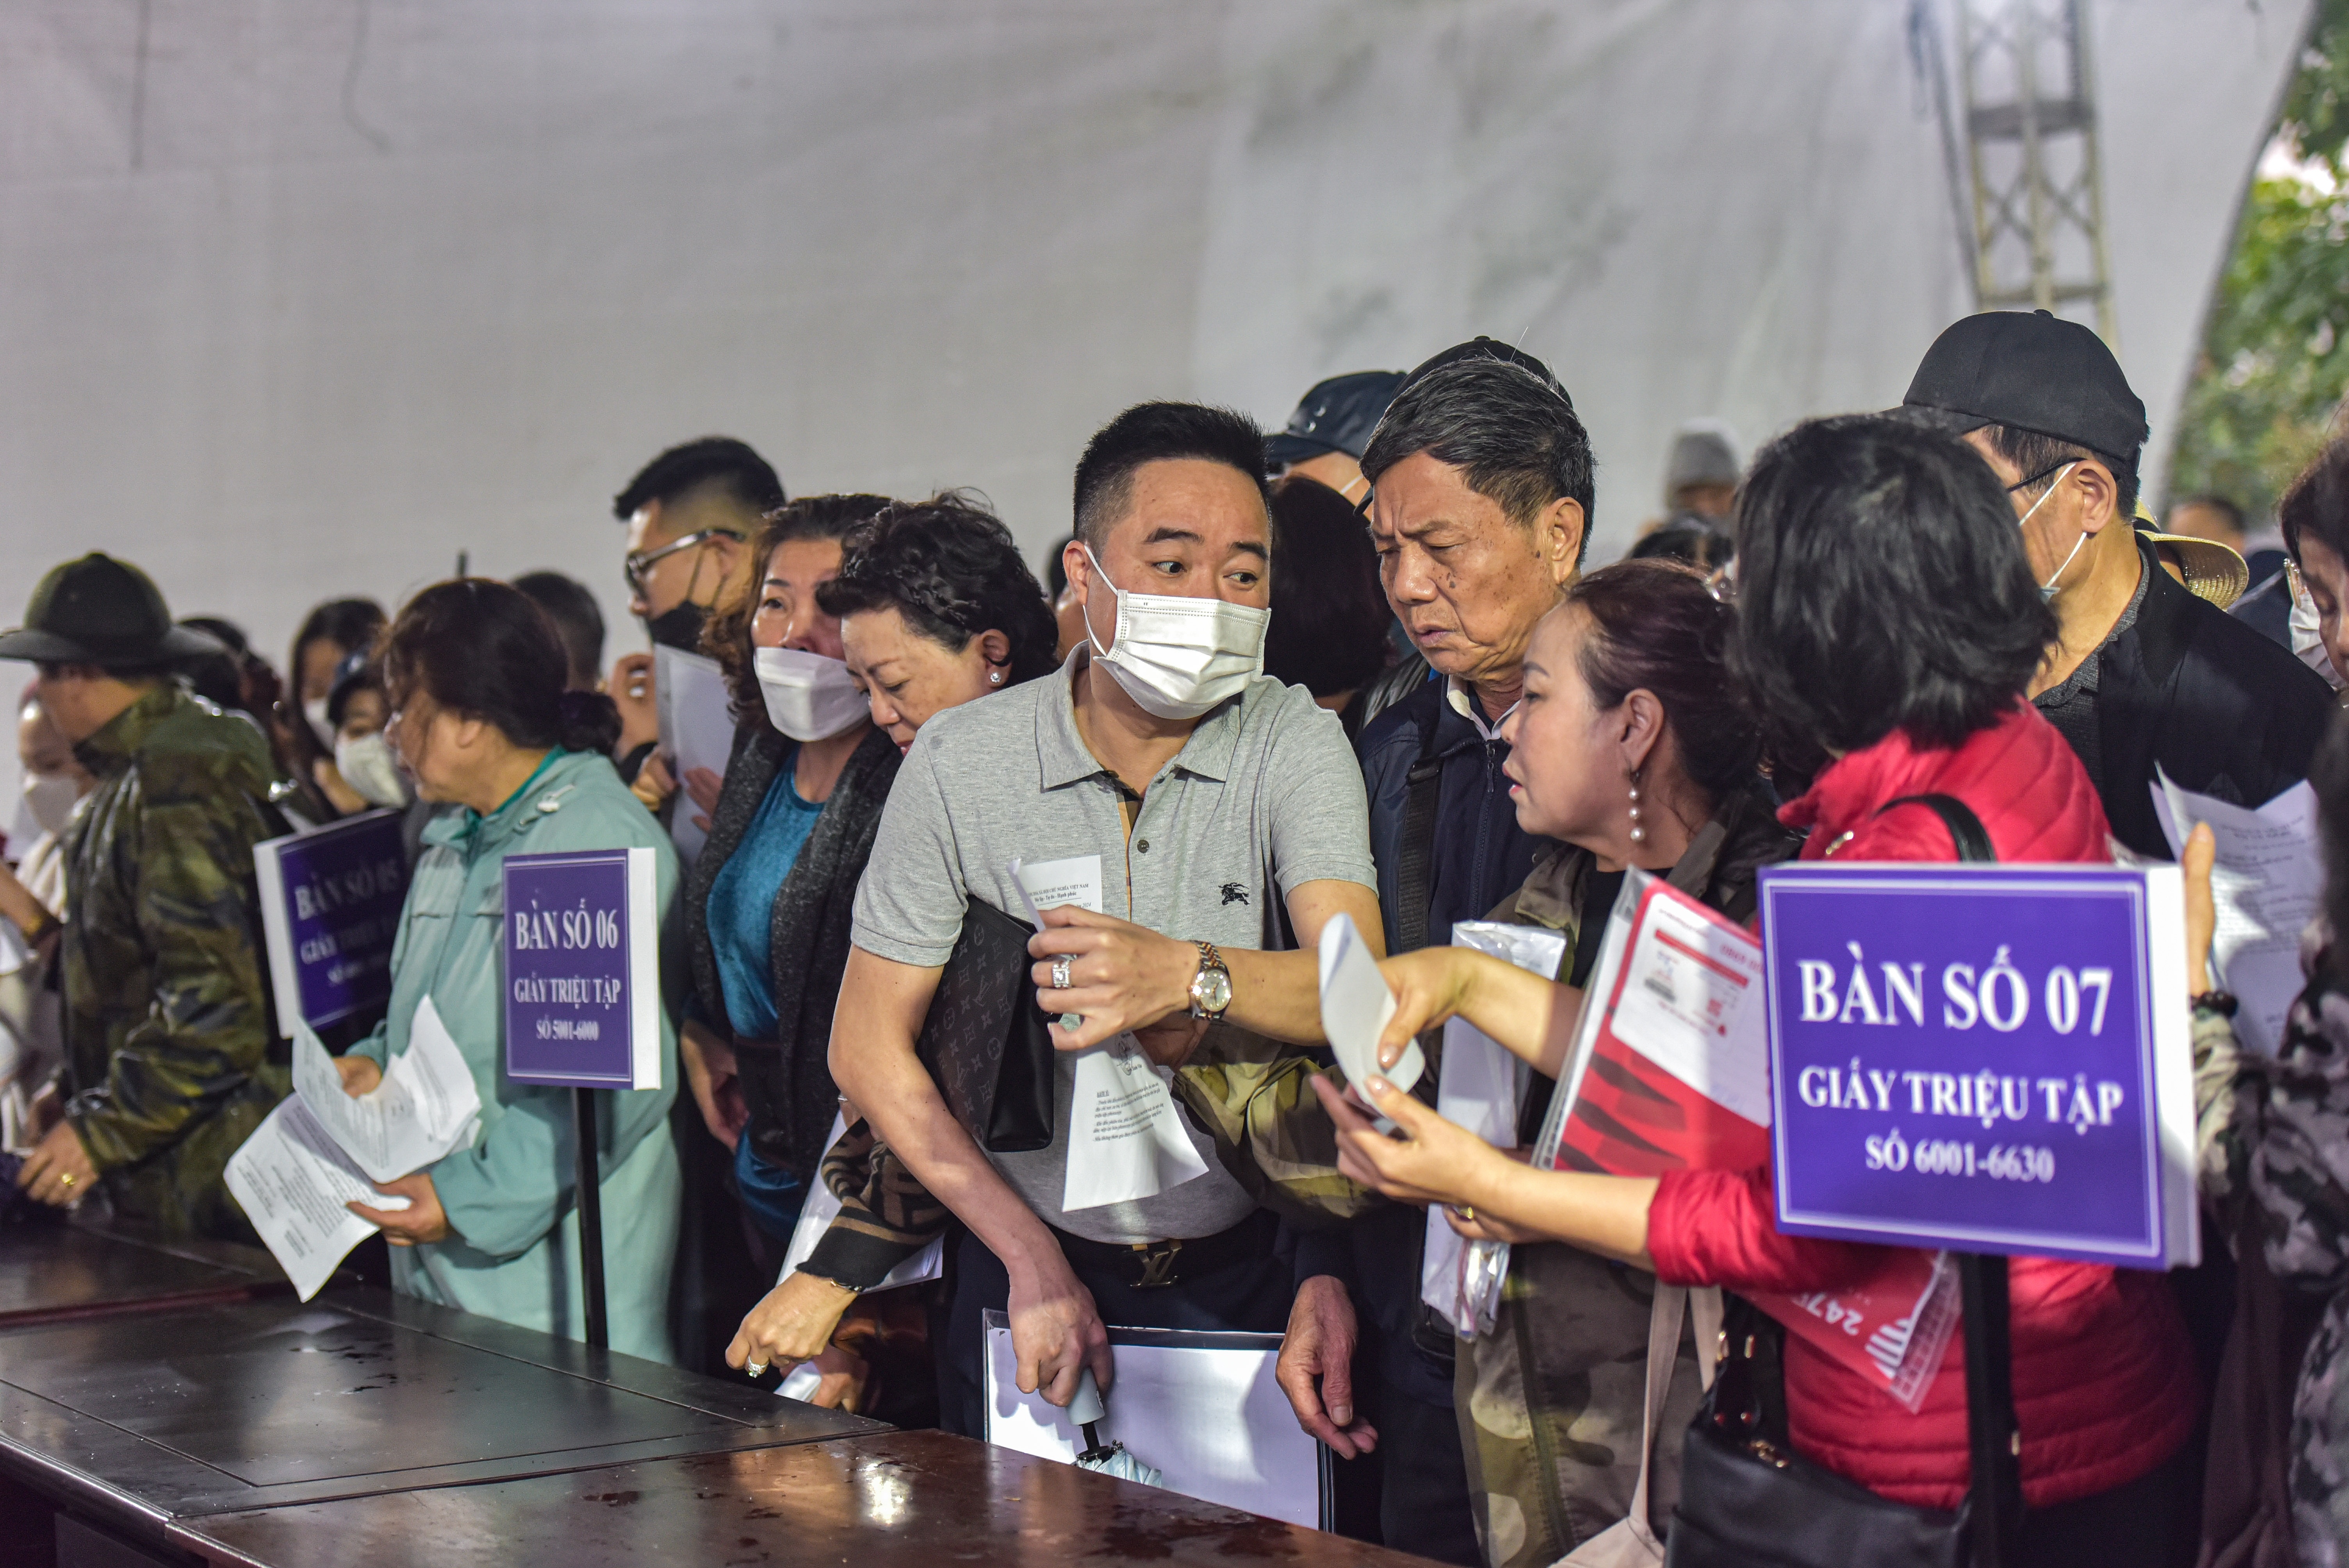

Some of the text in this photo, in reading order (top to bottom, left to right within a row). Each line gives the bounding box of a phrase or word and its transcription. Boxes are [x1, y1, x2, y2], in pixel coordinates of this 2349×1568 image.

[515, 898, 619, 950] BÀN SỐ 06
[513, 971, 622, 1010] GIẤY TRIỆU TẬP
[1796, 941, 1925, 1028] BÀN
[1941, 943, 2030, 1033] SỐ
[2044, 965, 2113, 1037] 07
[536, 1015, 599, 1041] SỐ 5001-6000
[1798, 1057, 2124, 1135] GIẤY TRIỆU TẬP
[1865, 1127, 2055, 1183] SỐ 6001-6630
